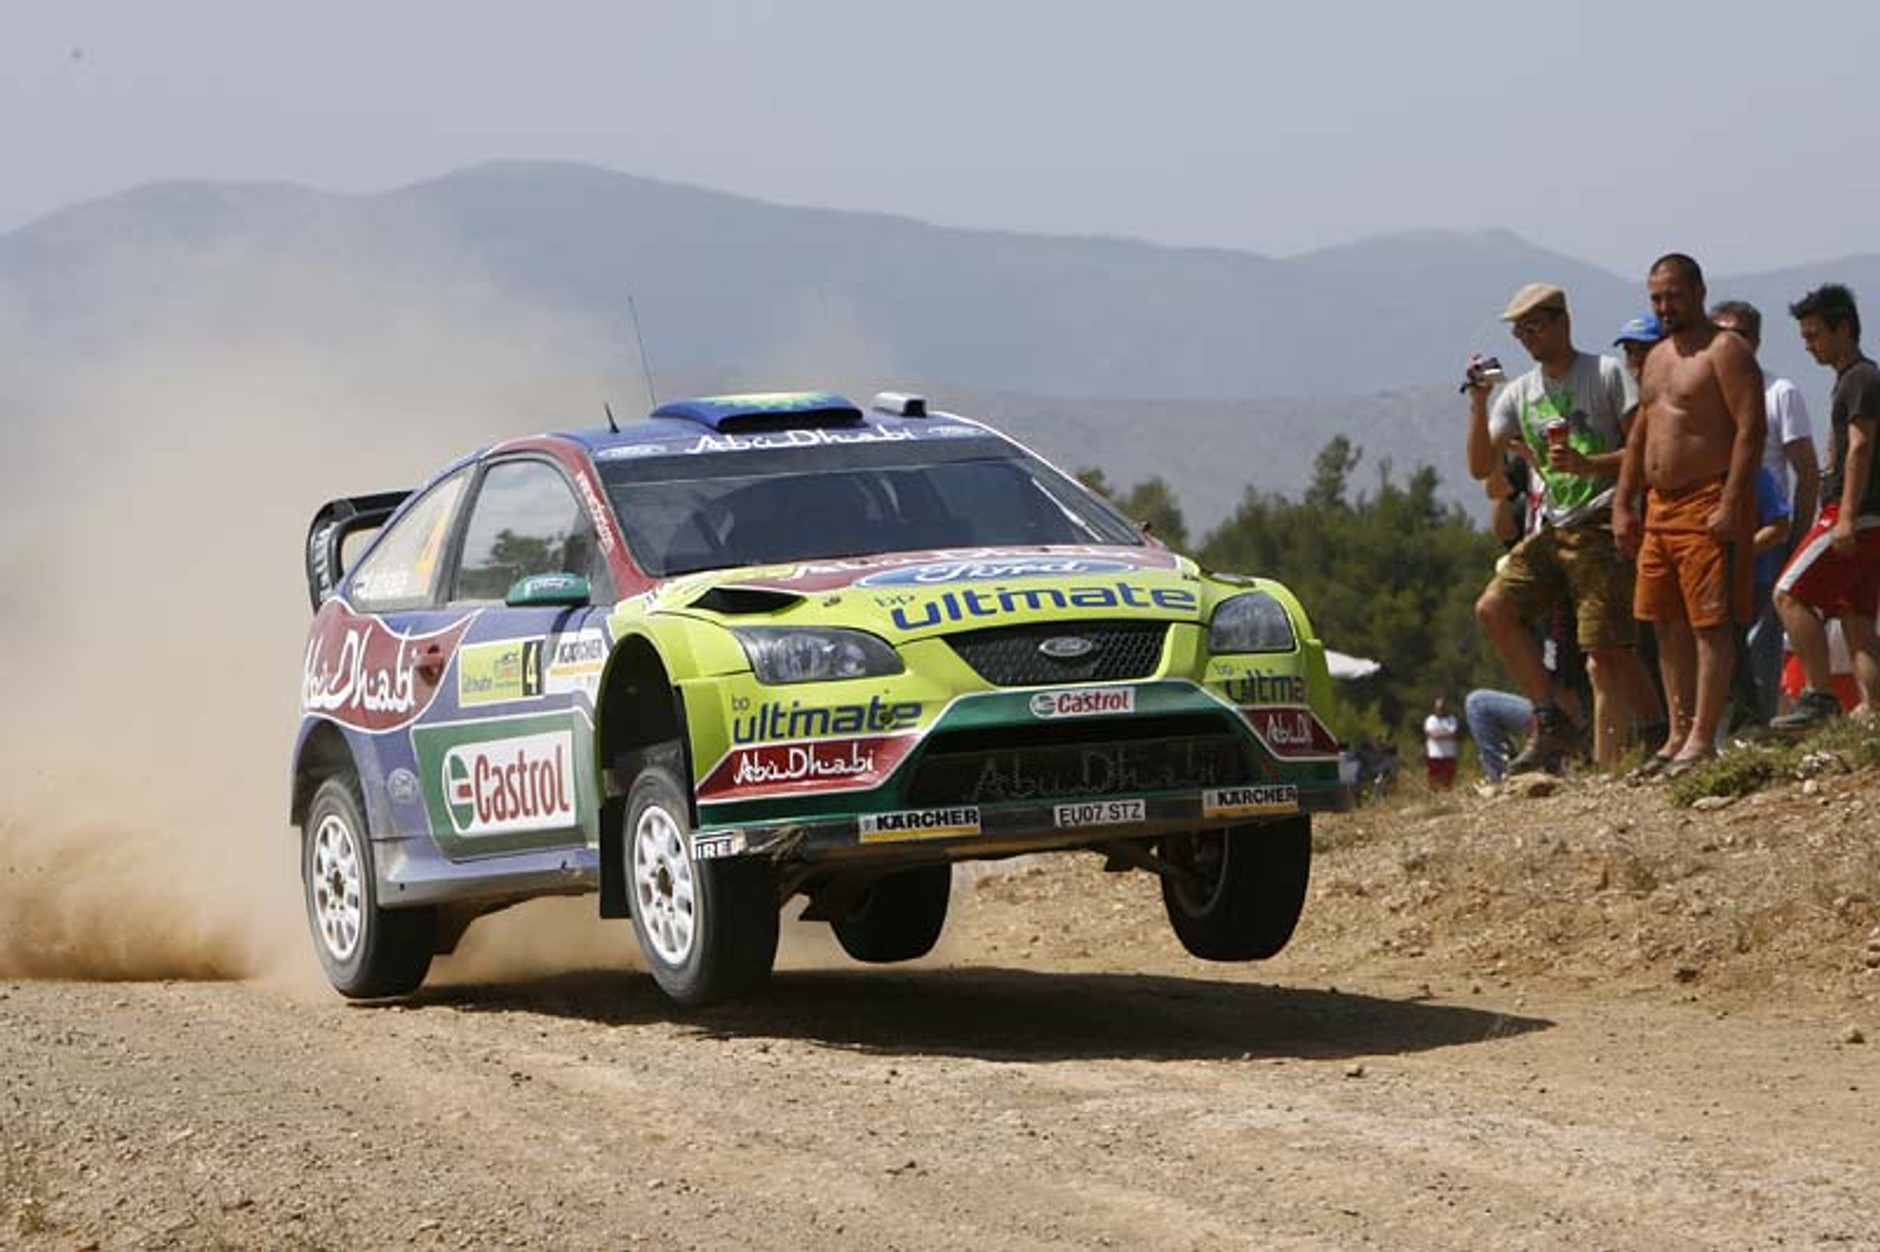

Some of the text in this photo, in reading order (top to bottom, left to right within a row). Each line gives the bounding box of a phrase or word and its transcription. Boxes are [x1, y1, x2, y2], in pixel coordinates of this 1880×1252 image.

[914, 558, 1085, 583] Ford
[890, 582, 1197, 630] ultimate
[526, 643, 537, 694] 4
[734, 696, 922, 744] ultimate
[1058, 690, 1129, 713] Castrol
[475, 745, 570, 823] Castrol
[1059, 802, 1143, 825] EU07 STZ
